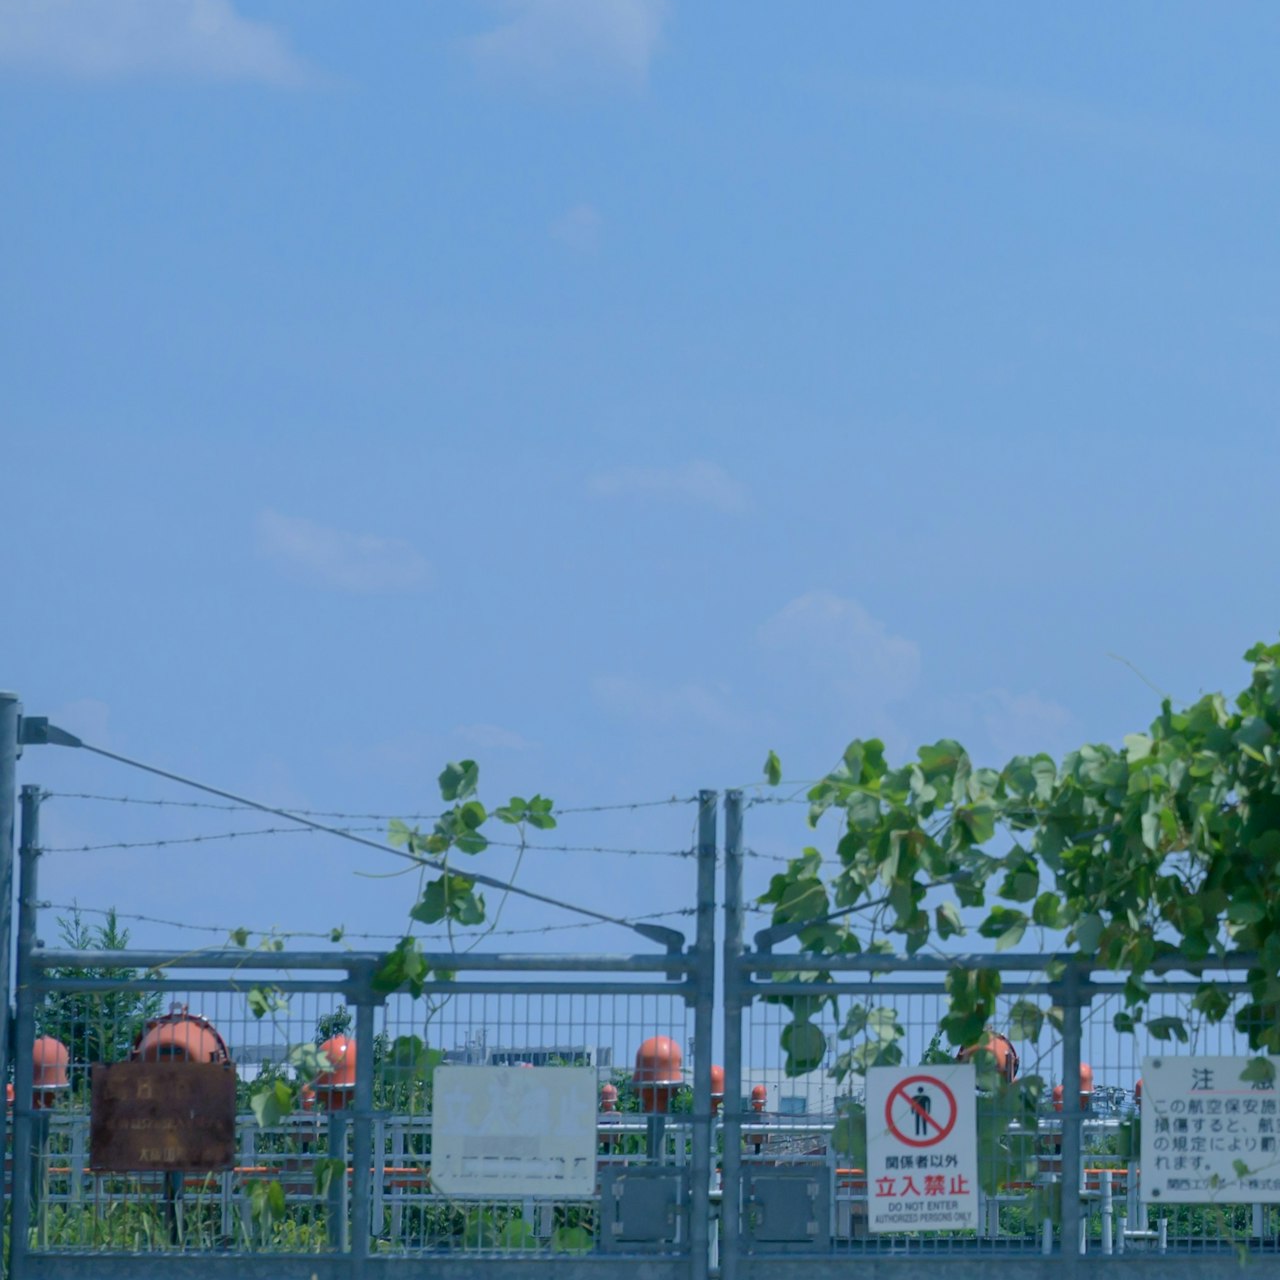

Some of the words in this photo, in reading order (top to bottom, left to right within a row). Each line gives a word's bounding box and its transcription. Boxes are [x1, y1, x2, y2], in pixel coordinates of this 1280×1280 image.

[885, 1154, 958, 1169] 関係者以外
[1155, 1155, 1211, 1171] れます。
[875, 1173, 970, 1197] 立入禁止
[888, 1202, 902, 1212] DO
[905, 1201, 924, 1211] NOT
[927, 1200, 958, 1211] ENTER
[874, 1213, 918, 1224] AUTHORIZED
[920, 1211, 952, 1223] PERSONS
[954, 1210, 972, 1222] ONLY
